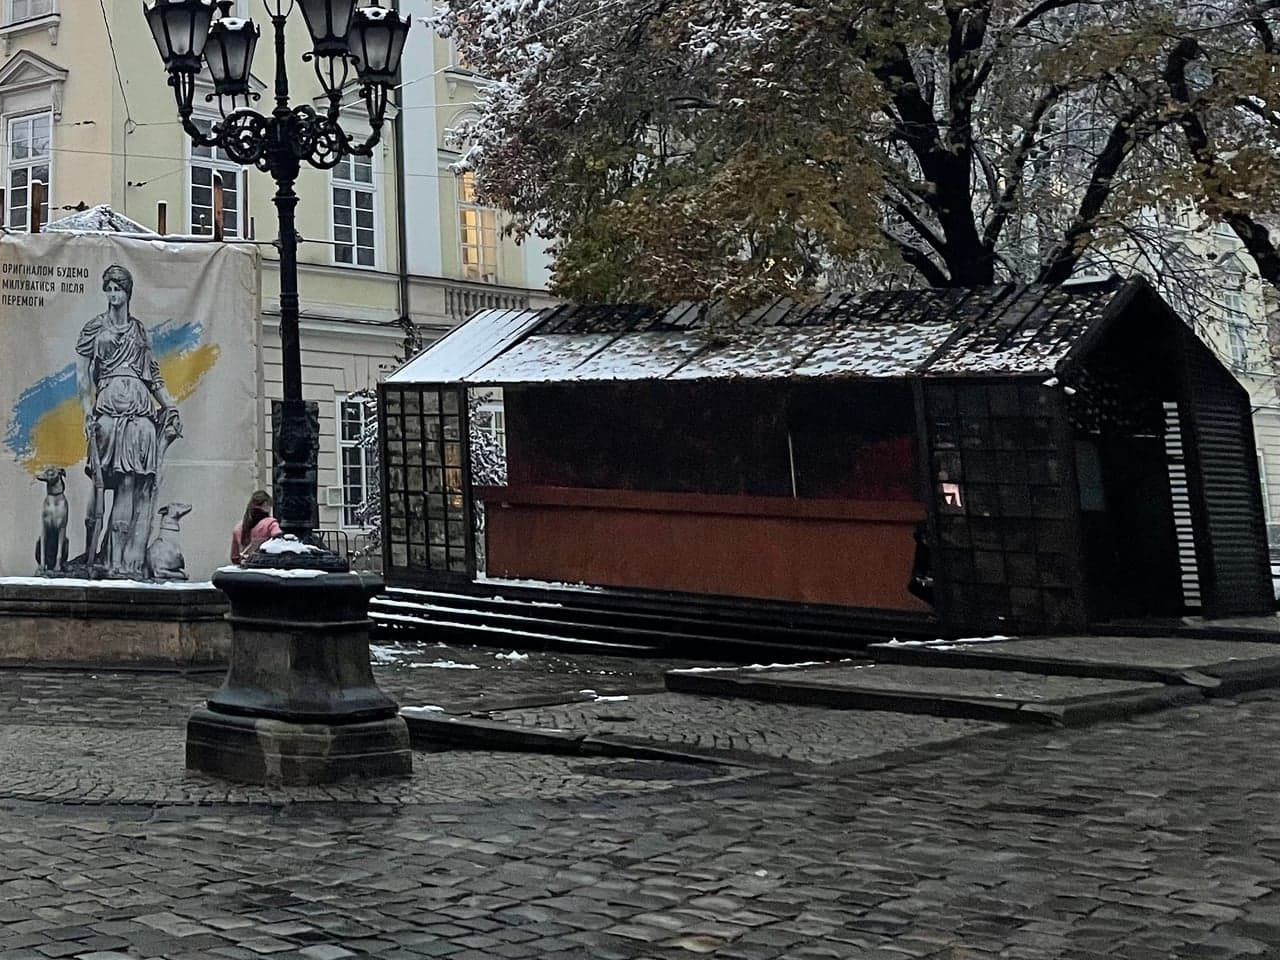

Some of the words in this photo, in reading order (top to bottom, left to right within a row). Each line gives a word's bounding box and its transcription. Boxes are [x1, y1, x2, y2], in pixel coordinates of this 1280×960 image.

[2, 263, 54, 277] ОРИГІНАЛОМ
[56, 266, 89, 278] БУДЕМО
[2, 279, 55, 292] МИЛУВАТИСЯ
[61, 282, 84, 294] ПІСЛЯ
[2, 294, 44, 307] ПЕРЕМОГИ
